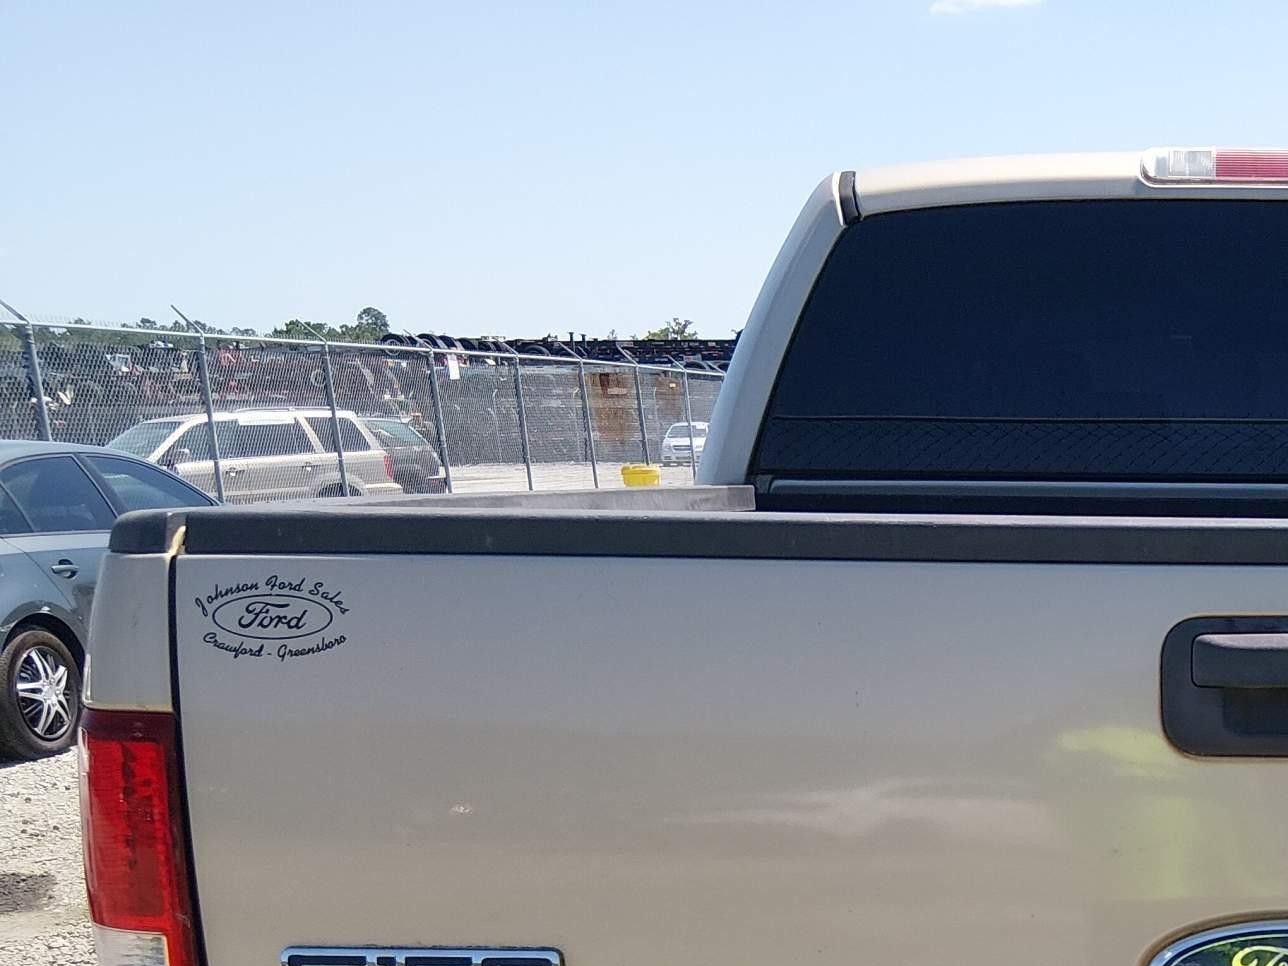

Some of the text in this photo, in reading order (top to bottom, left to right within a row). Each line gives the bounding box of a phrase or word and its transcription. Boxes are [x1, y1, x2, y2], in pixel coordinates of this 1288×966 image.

[195, 575, 350, 617] Johnson Ford Sales
[238, 601, 308, 630] Ford
[203, 632, 265, 659] Crawford
[277, 634, 347, 662] Greensboro
